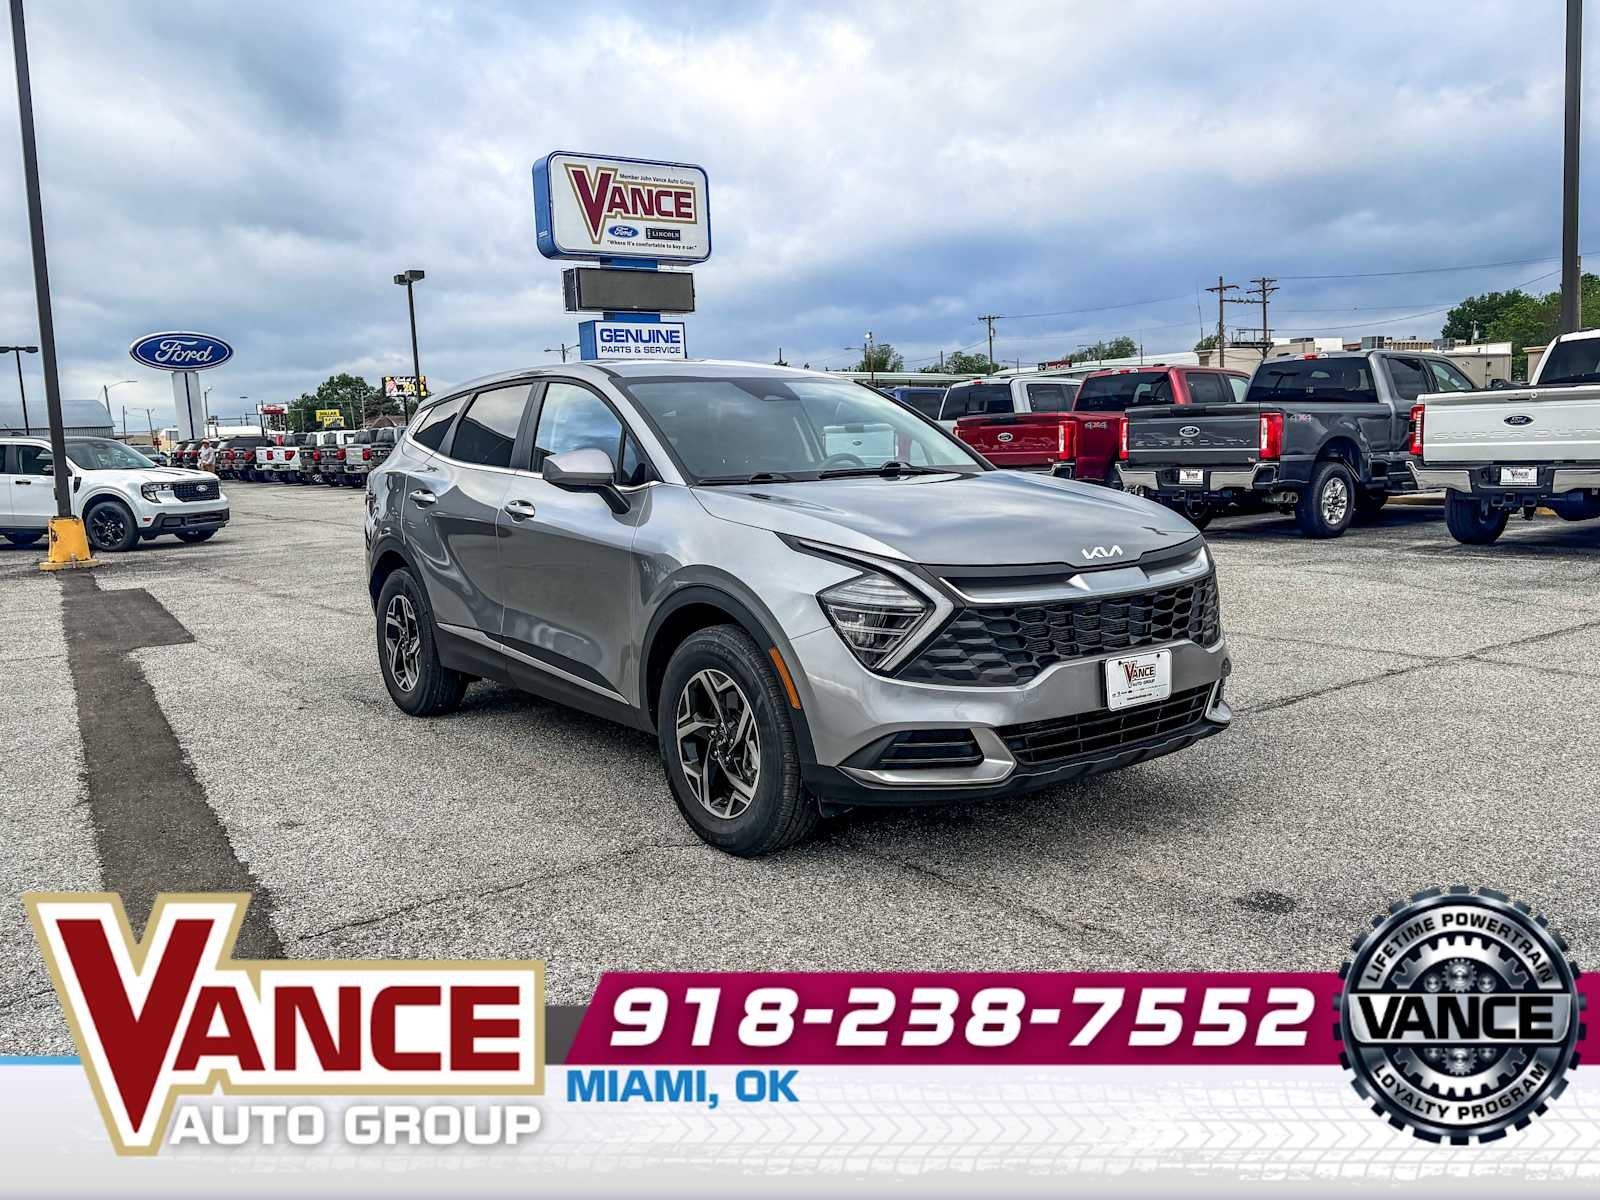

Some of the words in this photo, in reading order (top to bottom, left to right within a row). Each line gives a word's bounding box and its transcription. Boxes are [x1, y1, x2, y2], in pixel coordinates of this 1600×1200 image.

[571, 170, 693, 237] VANCE
[613, 227, 635, 237] Ford
[652, 231, 680, 239] LINCOLN
[600, 328, 681, 344] GENUINE
[154, 339, 214, 362] Ford
[601, 345, 632, 353] PARTS
[643, 346, 681, 354] SERVICE
[1081, 544, 1124, 560] KIA
[1124, 663, 1155, 683] VANCE
